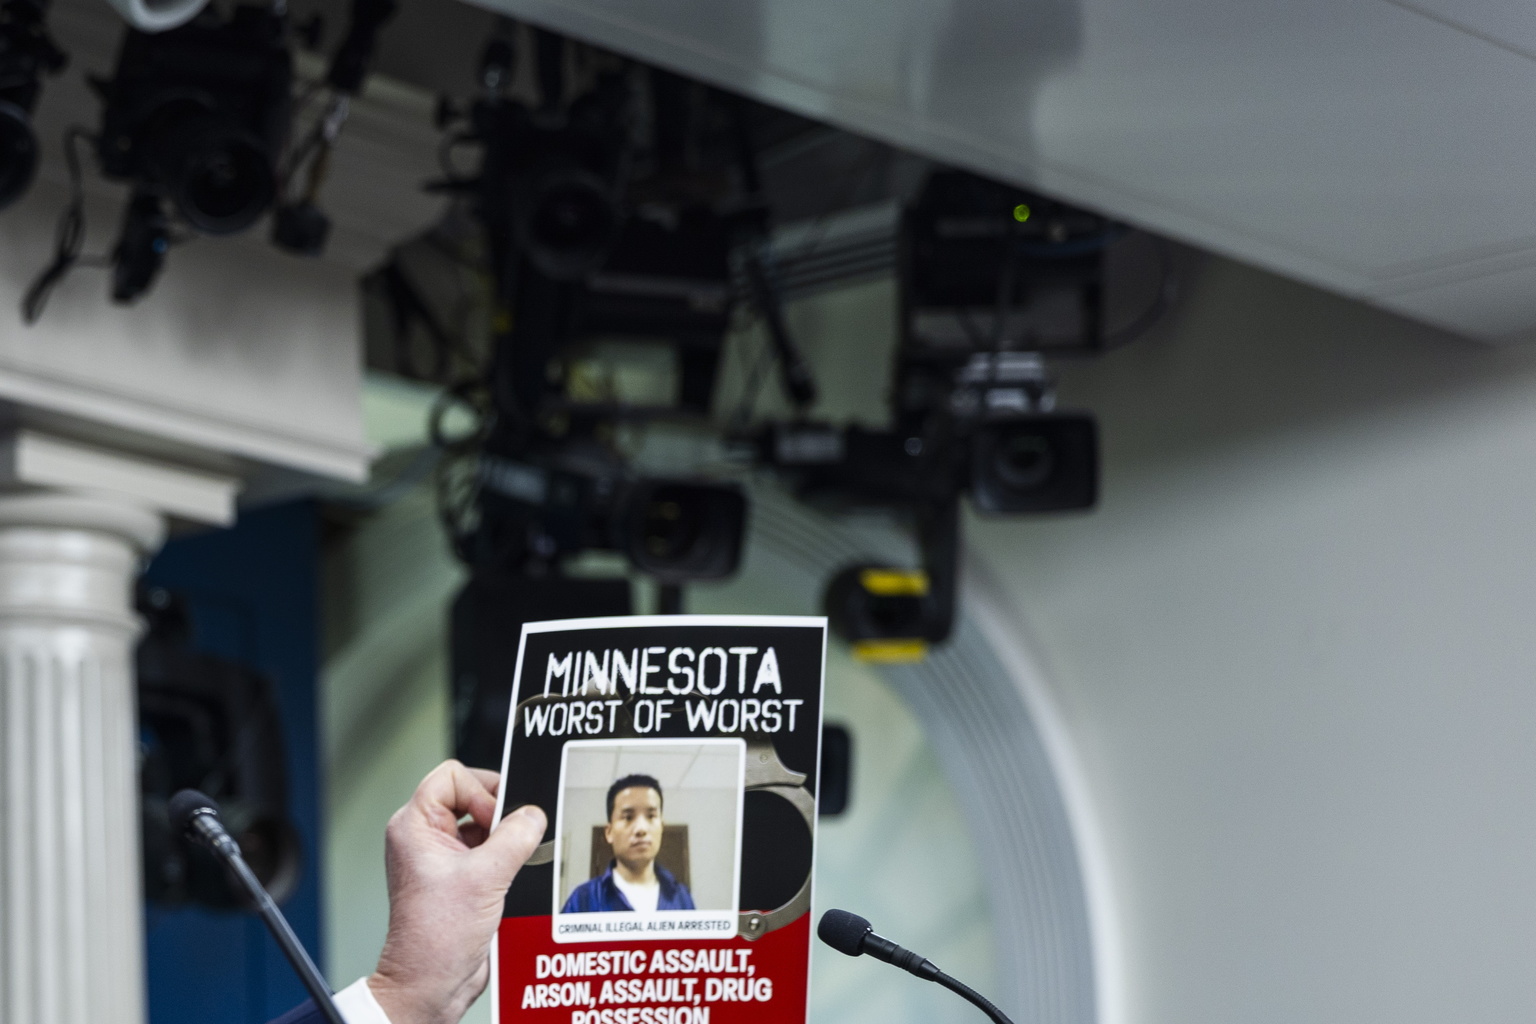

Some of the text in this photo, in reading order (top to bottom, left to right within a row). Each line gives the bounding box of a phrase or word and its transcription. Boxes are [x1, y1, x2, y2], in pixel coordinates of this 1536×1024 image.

[543, 647, 782, 698] MINNESOTA
[524, 699, 804, 738] WORST OF WORST
[558, 920, 732, 935] CRIMINAL ILLEGAL ALIEN ARRESTED
[536, 949, 756, 979] DOMESTIC ASSAULT,
[522, 977, 773, 1009] ARSON, ASSAULT, DRUG
